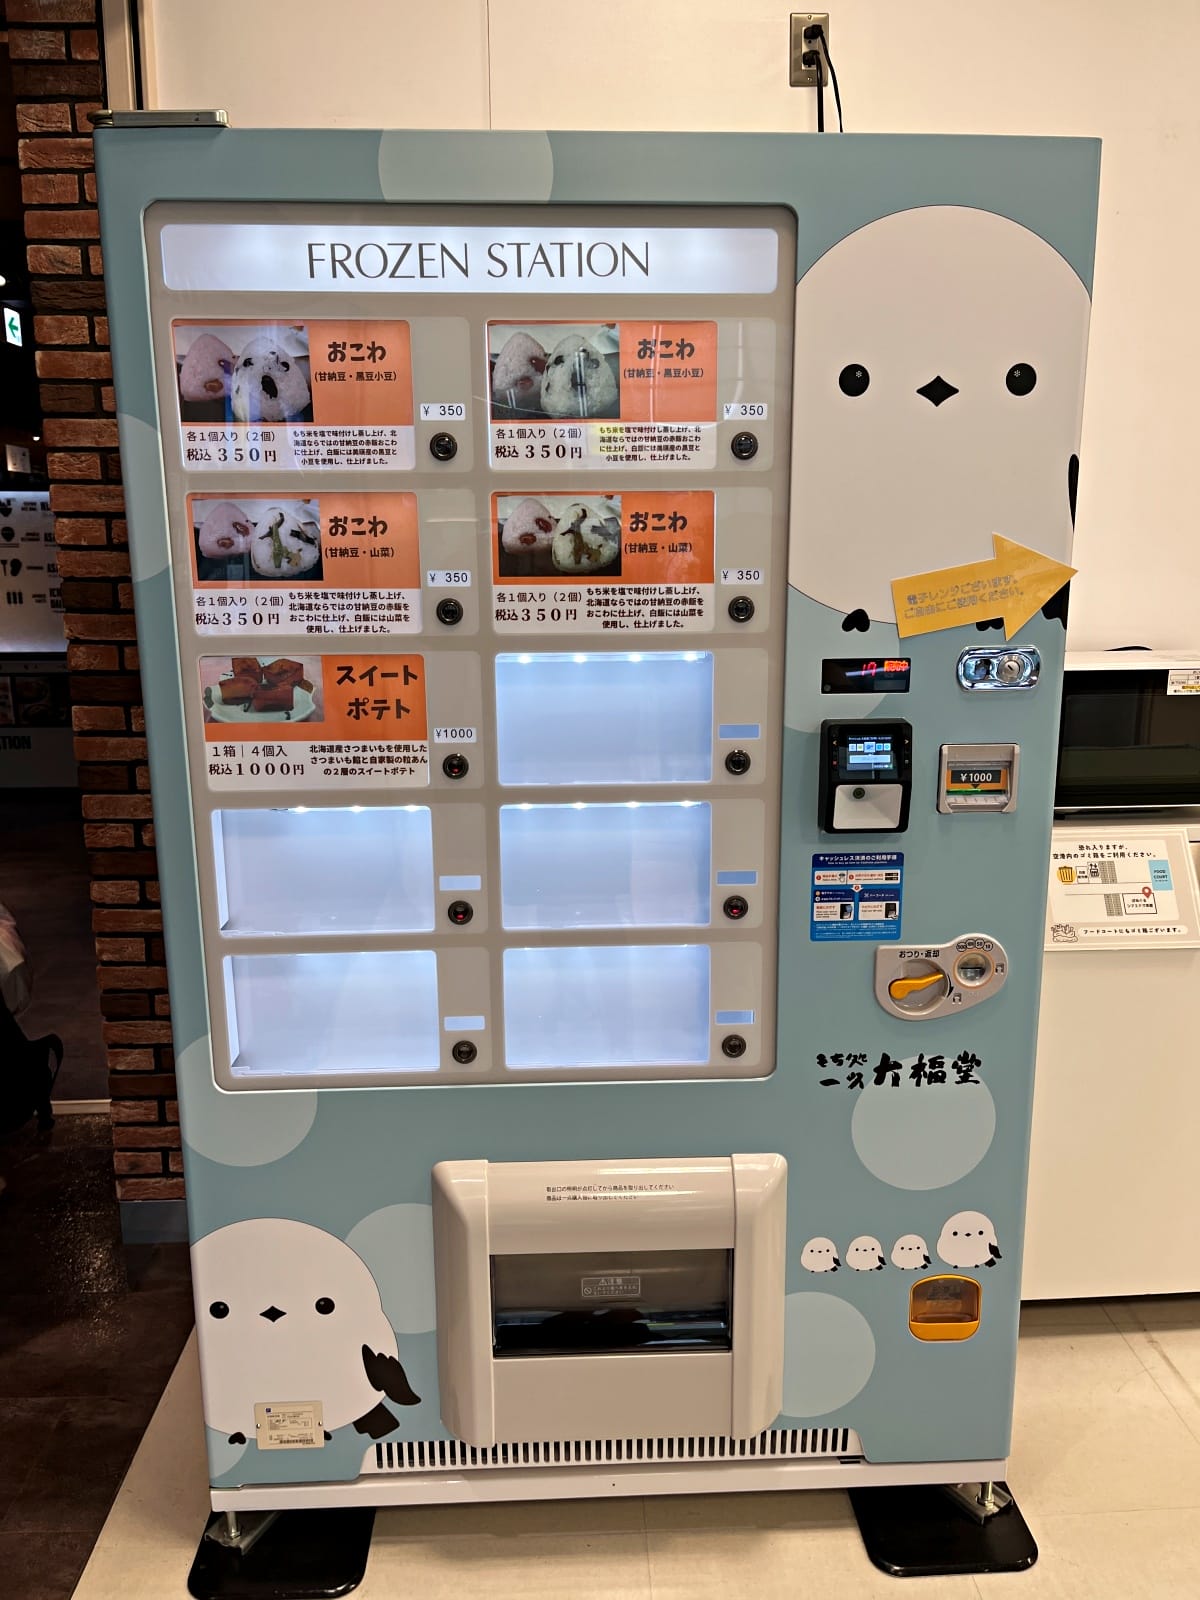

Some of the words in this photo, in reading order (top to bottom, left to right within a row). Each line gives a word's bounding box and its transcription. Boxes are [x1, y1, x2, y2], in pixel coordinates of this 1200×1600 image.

[308, 242, 469, 279] FROZEN
[487, 241, 649, 278] STATION
[328, 341, 386, 363] おこわ
[637, 338, 695, 361] おこわ
[439, 405, 463, 416] 350
[740, 405, 764, 416] 350
[328, 516, 388, 537] おこわ
[629, 511, 688, 532] おこわ
[445, 572, 468, 583] 350
[737, 570, 760, 581] 350
[335, 664, 418, 686] スイート
[346, 698, 411, 721] ポテト
[899, 949, 940, 958] おつり・返却
